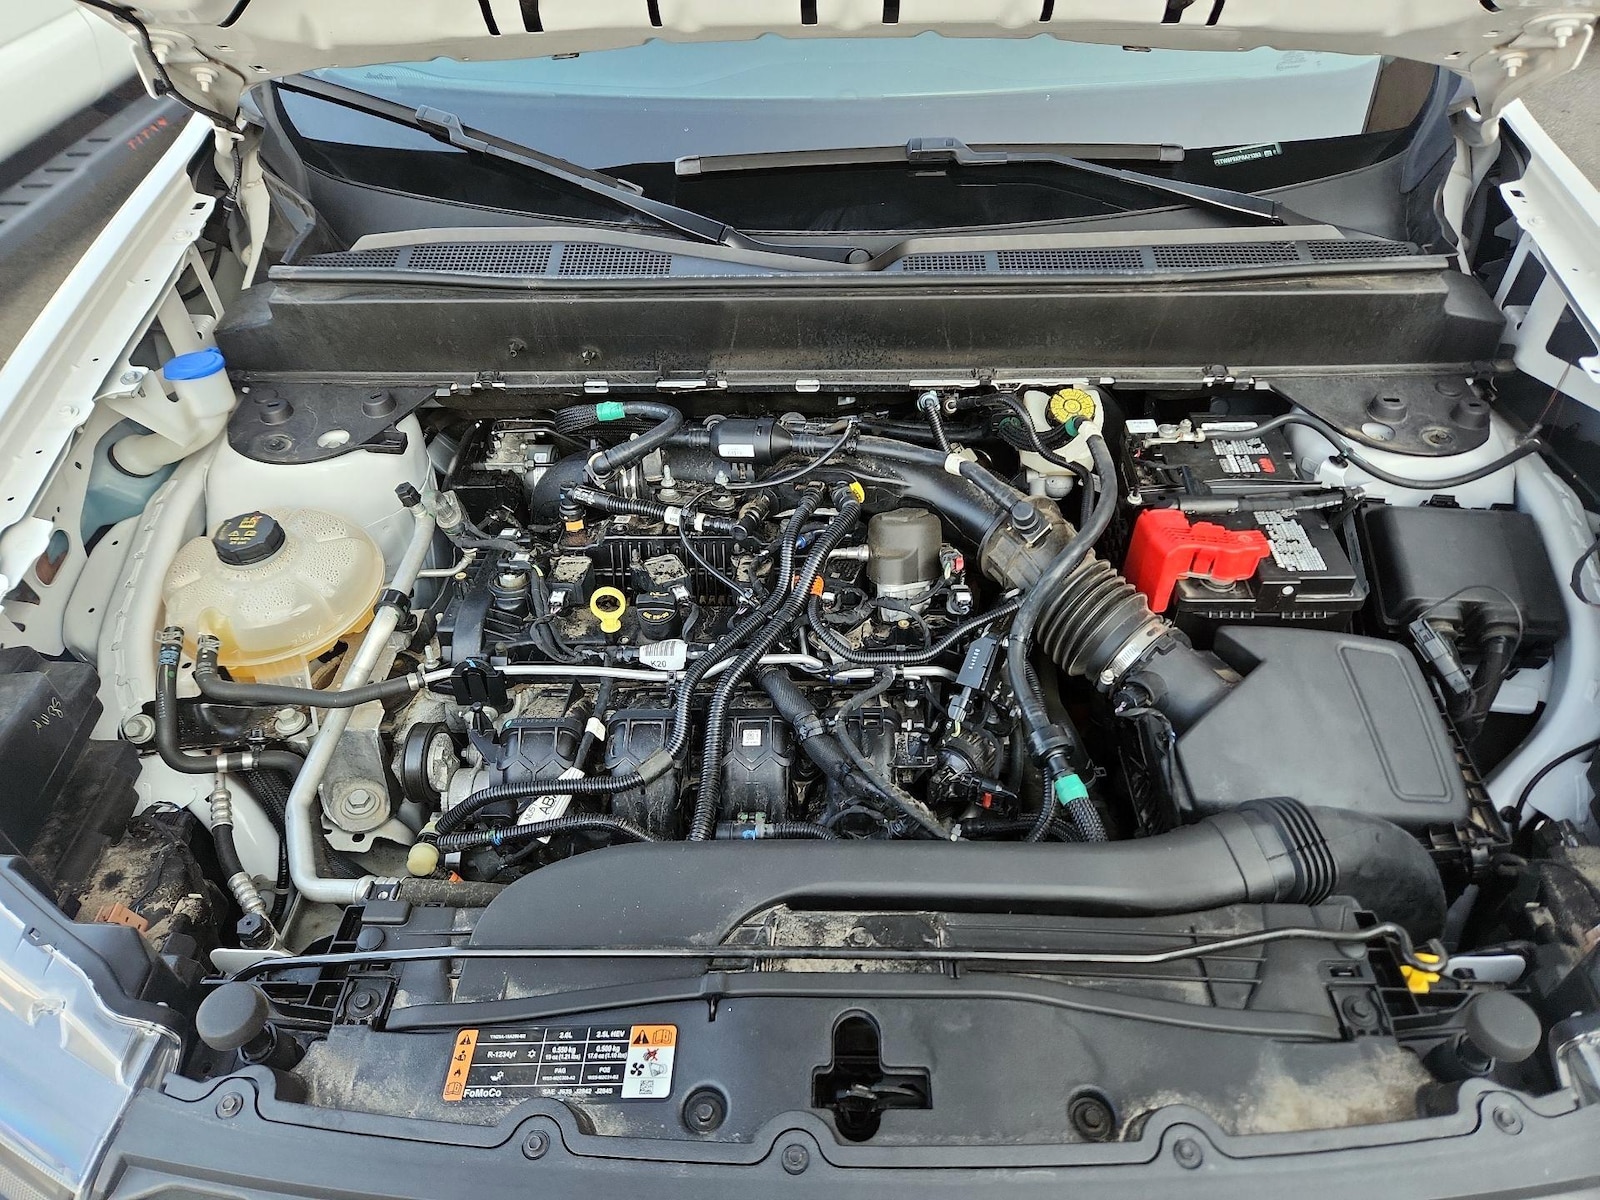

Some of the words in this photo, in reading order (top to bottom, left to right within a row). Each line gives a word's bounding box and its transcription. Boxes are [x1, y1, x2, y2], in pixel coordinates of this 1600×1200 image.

[650, 660, 667, 668] K20
[610, 1030, 626, 1038] HEV
[487, 1050, 518, 1060] R-1234yf
[463, 1088, 502, 1098] FoMoCo
